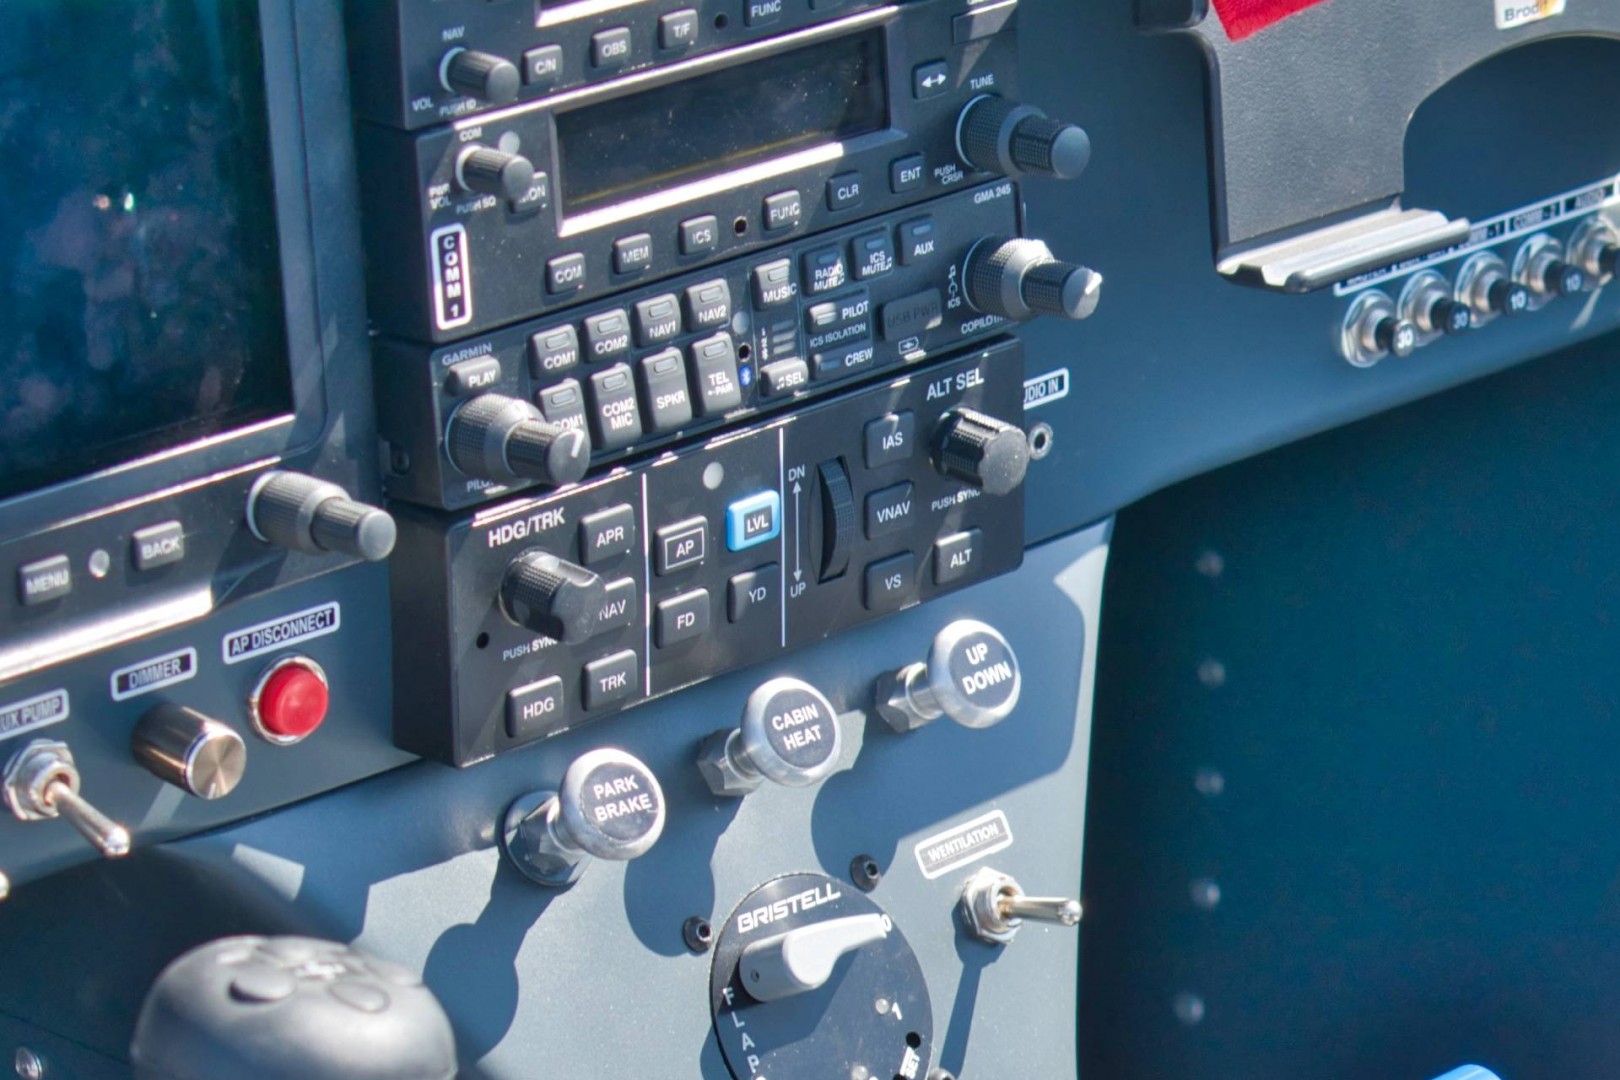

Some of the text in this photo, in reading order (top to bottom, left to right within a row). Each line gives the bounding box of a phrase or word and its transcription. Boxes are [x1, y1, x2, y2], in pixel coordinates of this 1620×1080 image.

[751, 1, 781, 18] FUNC
[442, 26, 465, 41] NAV
[673, 22, 691, 38] T/F
[602, 41, 627, 57] OBS
[535, 58, 556, 74] C/N
[970, 75, 994, 90] TUNE
[412, 98, 433, 112] VOL
[460, 126, 483, 142] COM
[900, 166, 922, 183] ENT
[934, 164, 957, 178] PUSH
[837, 183, 859, 200] CLR
[974, 184, 1012, 205] GMA 245
[430, 197, 451, 211] VOL
[770, 202, 800, 222] FUNC
[693, 228, 712, 244] ICS
[622, 246, 649, 264] MEM
[870, 251, 886, 263] ICS
[914, 240, 934, 256] AUX
[443, 236, 461, 298] COMM
[555, 264, 583, 284] COM
[814, 263, 844, 281] RADIO
[862, 261, 885, 275] MUTE
[813, 274, 839, 291] MUTE
[1566, 274, 1581, 291] 10
[763, 282, 797, 303] MUSIC
[1511, 292, 1527, 309] 10
[842, 300, 869, 320] PILOT
[947, 296, 961, 310] ICS
[698, 306, 727, 322] NAV2
[1452, 311, 1468, 328] 30
[650, 321, 676, 338] NAV1
[810, 323, 867, 348] ICS ISOLATION
[595, 334, 628, 354] COM2
[1397, 329, 1414, 349] 30
[442, 342, 493, 366] GARMIN
[544, 350, 576, 370] COM1
[845, 347, 873, 368] CREW
[468, 369, 497, 388] PLAY
[708, 373, 730, 385] TEL
[785, 371, 805, 387] SEL
[926, 368, 985, 401] ALT SEL
[1023, 377, 1059, 403] UDIO IN
[603, 397, 635, 418] COM2
[656, 391, 686, 409] SPKR
[610, 414, 633, 431] MIC
[883, 432, 904, 450] IAS
[788, 465, 805, 483] DN
[877, 500, 911, 523] VNAV
[931, 495, 957, 511] PUSH
[488, 507, 566, 548] HDG/TRK
[746, 511, 770, 534] LVL
[596, 526, 624, 548] APR
[142, 534, 181, 561] BACK
[676, 540, 695, 558] AP
[950, 548, 973, 569] ALT
[26, 568, 69, 595] MENU
[790, 581, 807, 599] UP
[885, 573, 902, 590] VS
[749, 586, 767, 603] YD
[599, 599, 626, 621] NAV
[677, 612, 695, 630] FD
[231, 609, 333, 656] AP DISCONNECT
[503, 644, 531, 661] PUSH
[966, 643, 989, 666] UP
[128, 658, 182, 689] DIMMER
[600, 672, 627, 693] TRK
[962, 661, 1012, 695] DOWN
[0, 697, 61, 733] UX PUMP
[523, 697, 555, 720] HDG
[771, 704, 819, 732] CABIN
[783, 725, 823, 751] HEAT
[593, 775, 639, 799] PARK
[594, 793, 653, 823] BRAKE
[737, 883, 841, 933] BRISTELL
[891, 1002, 903, 1021] 1
